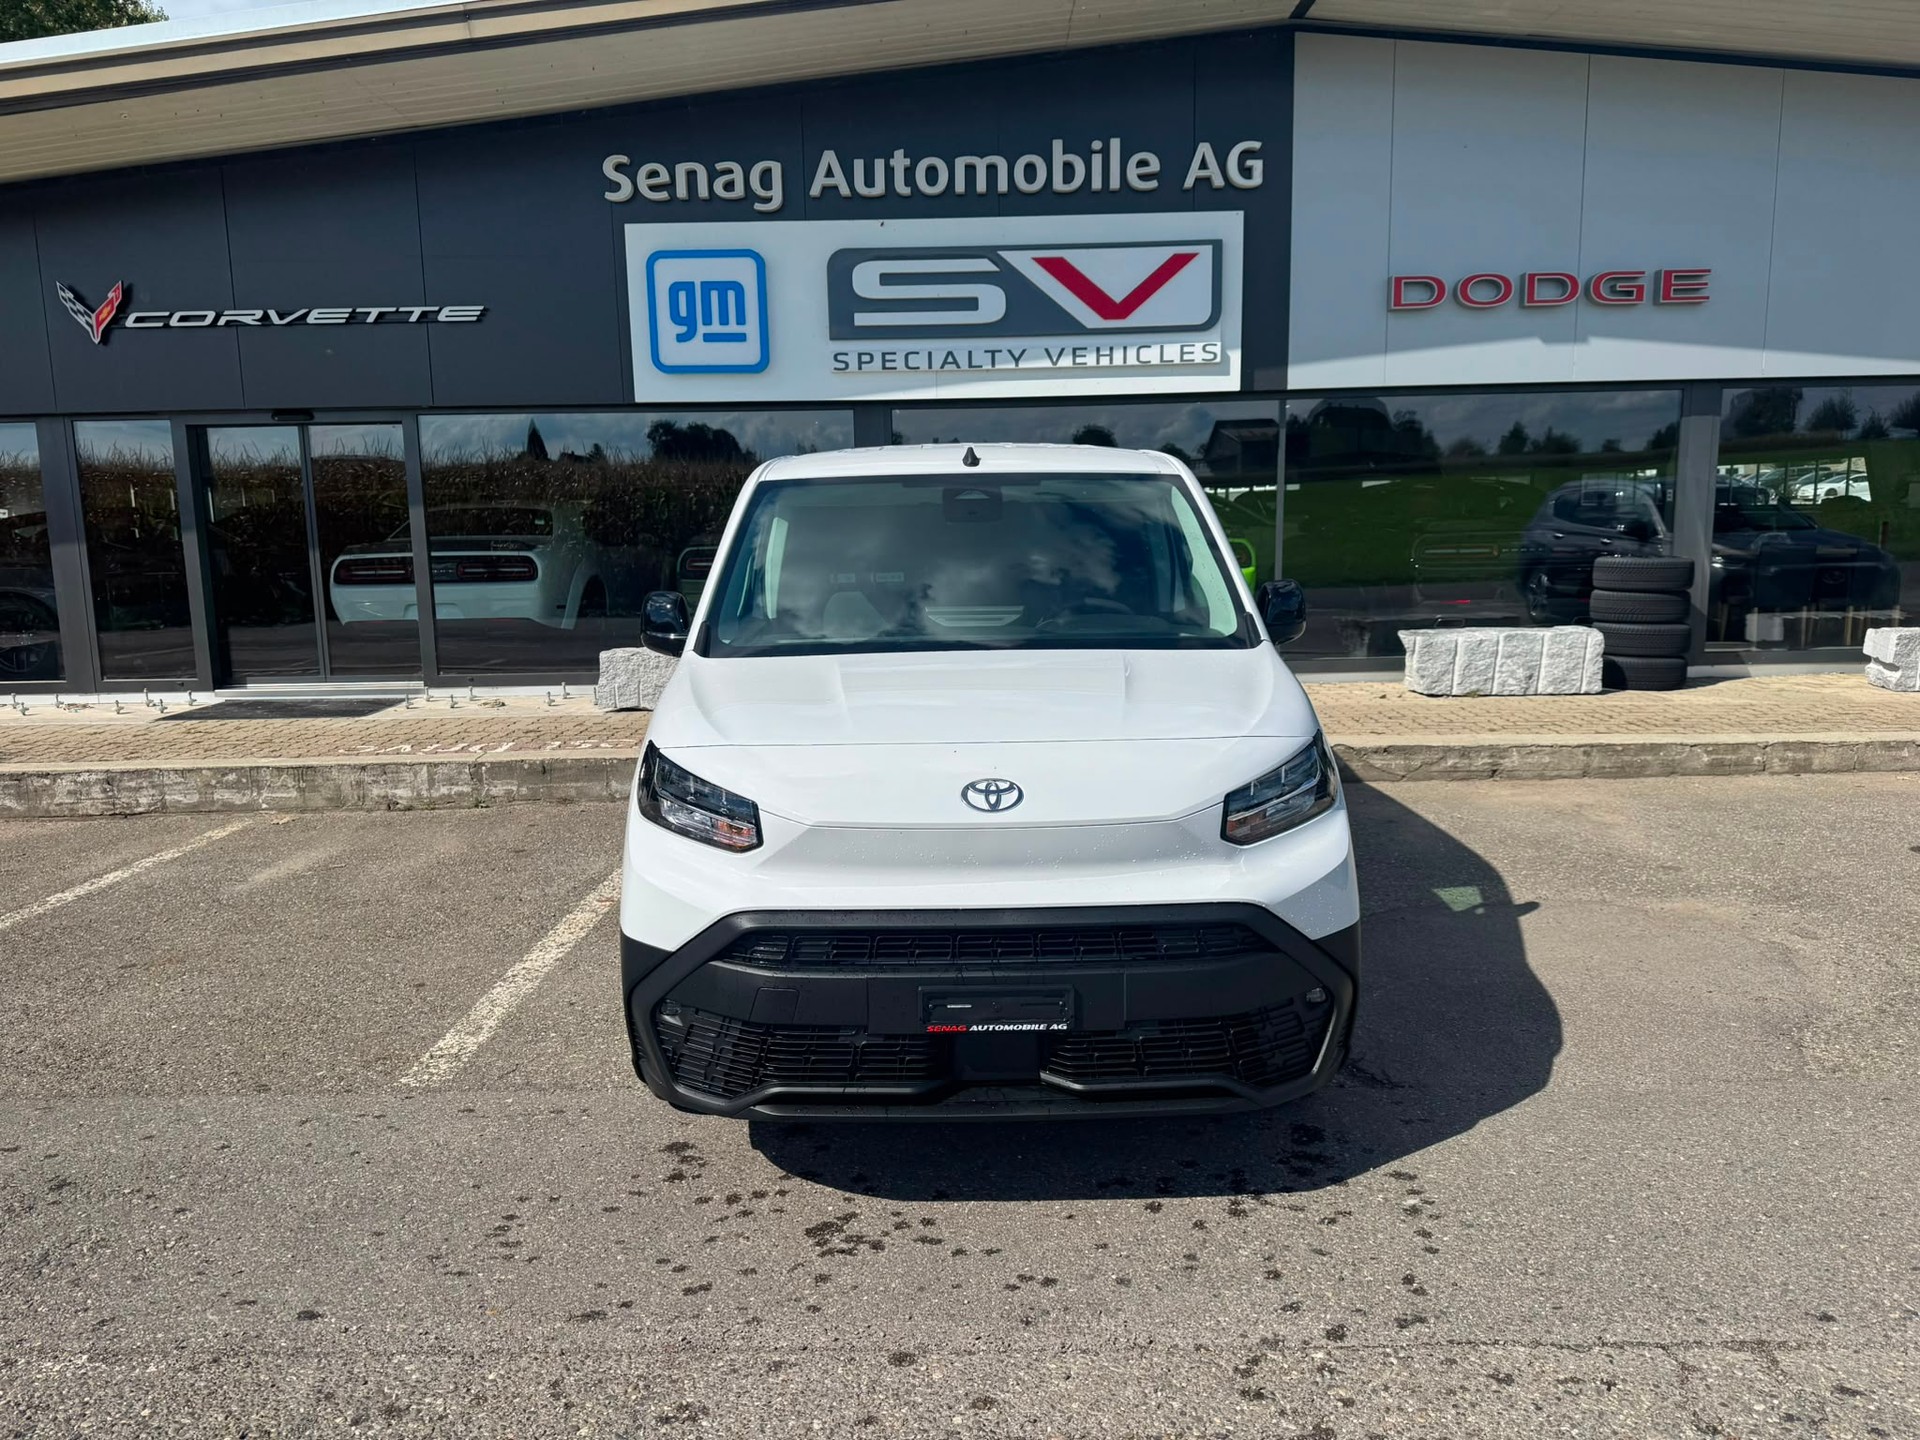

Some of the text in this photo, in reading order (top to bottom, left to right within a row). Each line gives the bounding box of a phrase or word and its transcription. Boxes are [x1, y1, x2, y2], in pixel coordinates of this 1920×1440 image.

[602, 137, 1264, 212] Senag Automobile AG
[1389, 268, 1712, 309] DODGE
[124, 304, 486, 328] CORVETTE
[668, 280, 747, 342] gm
[832, 342, 1220, 372] SPECIALTY VEHICLES
[926, 1023, 1068, 1033] SENAG AUTOMOBILE AG
